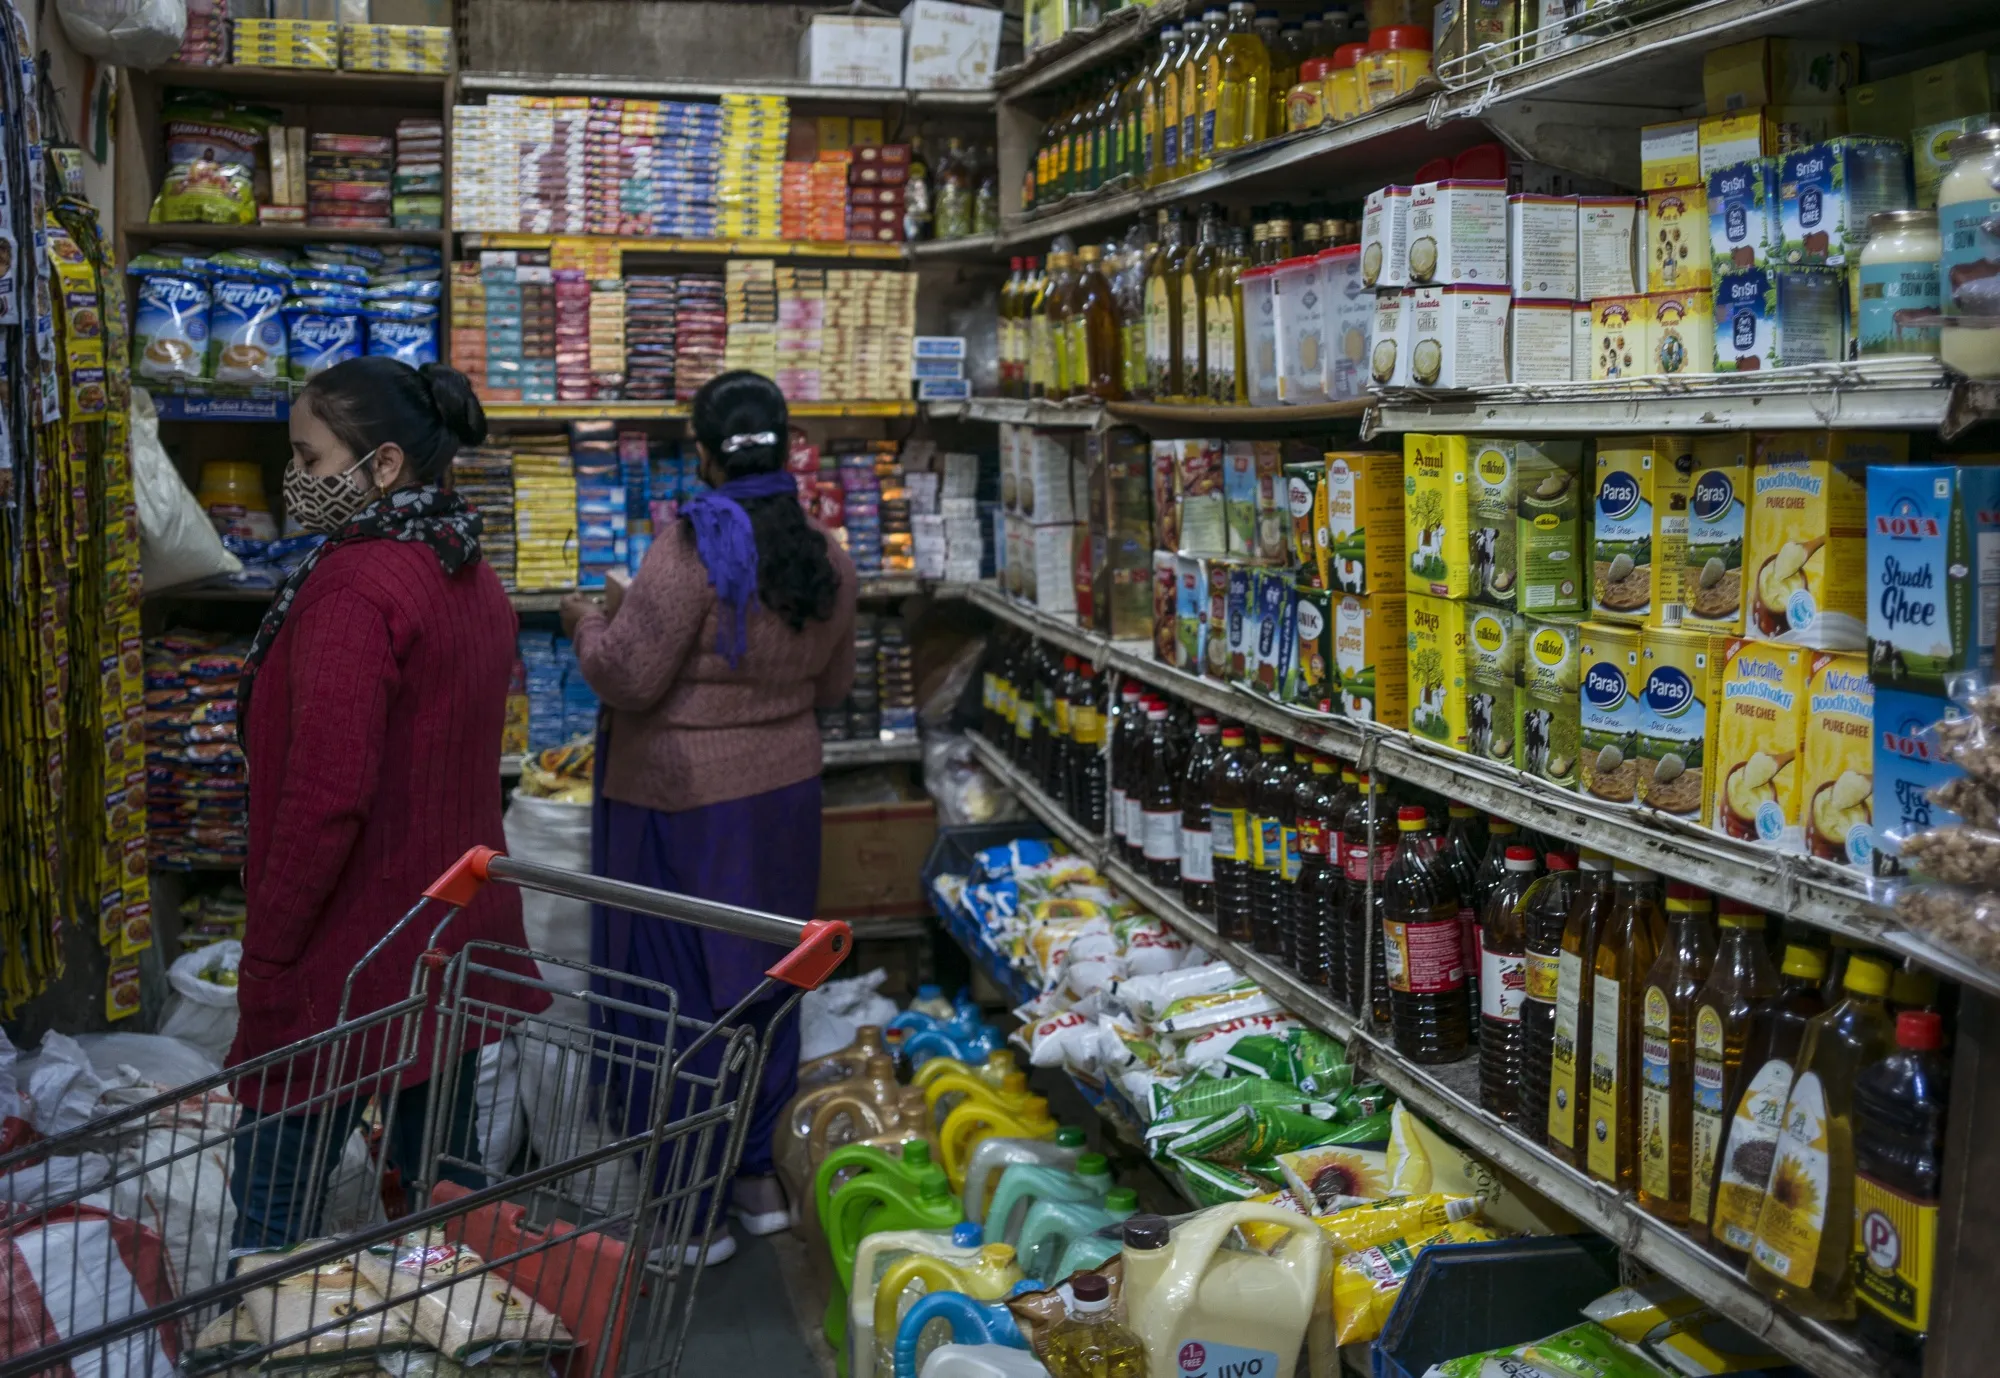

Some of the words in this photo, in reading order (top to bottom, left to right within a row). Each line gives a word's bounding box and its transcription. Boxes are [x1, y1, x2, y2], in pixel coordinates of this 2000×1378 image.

[1795, 158, 1824, 177] SriSri
[1720, 176, 1746, 194] SriSri
[1411, 197, 1435, 208] Ananda
[1801, 208, 1820, 224] GHEE
[1728, 223, 1745, 239] GHEE
[1900, 272, 1936, 281] TELLUS
[1731, 279, 1758, 299] SriSri
[1901, 282, 1922, 297] COW
[1415, 299, 1440, 309] Ananda
[1417, 316, 1438, 330] GHEE
[1736, 332, 1753, 347] GHEE
[1413, 447, 1443, 469] Amul
[1602, 482, 1632, 501] Paras
[1696, 484, 1726, 502] Paras
[1756, 471, 1823, 497] DoodhShakti
[1766, 496, 1785, 510] PURE
[1786, 497, 1806, 510] GHEE
[1875, 516, 1941, 537] NOVA
[1881, 555, 1934, 590] Shudh
[1880, 585, 1936, 631] Ghee
[1476, 627, 1501, 644] milkfood
[1535, 639, 1563, 658] milkfood
[1537, 666, 1556, 681] RICH
[1737, 658, 1784, 682] Nutrolite
[1588, 671, 1619, 694] Paras
[1650, 676, 1684, 700] Paras
[1726, 680, 1794, 711] DoodhShakti
[1735, 702, 1755, 717] PURE
[1755, 707, 1777, 722] GHEE
[1812, 694, 1874, 721] DoodhSha
[1591, 713, 1603, 724] Desi
[1604, 716, 1619, 728] Ghee
[1651, 720, 1664, 732] Desi
[1665, 722, 1683, 735] Ghee
[1822, 718, 1844, 735] PURE
[1845, 721, 1870, 739] GHEE
[1644, 1041, 1668, 1058] KANODIA
[1696, 1064, 1721, 1081] KANODIA
[1182, 1357, 1202, 1368] FREE
